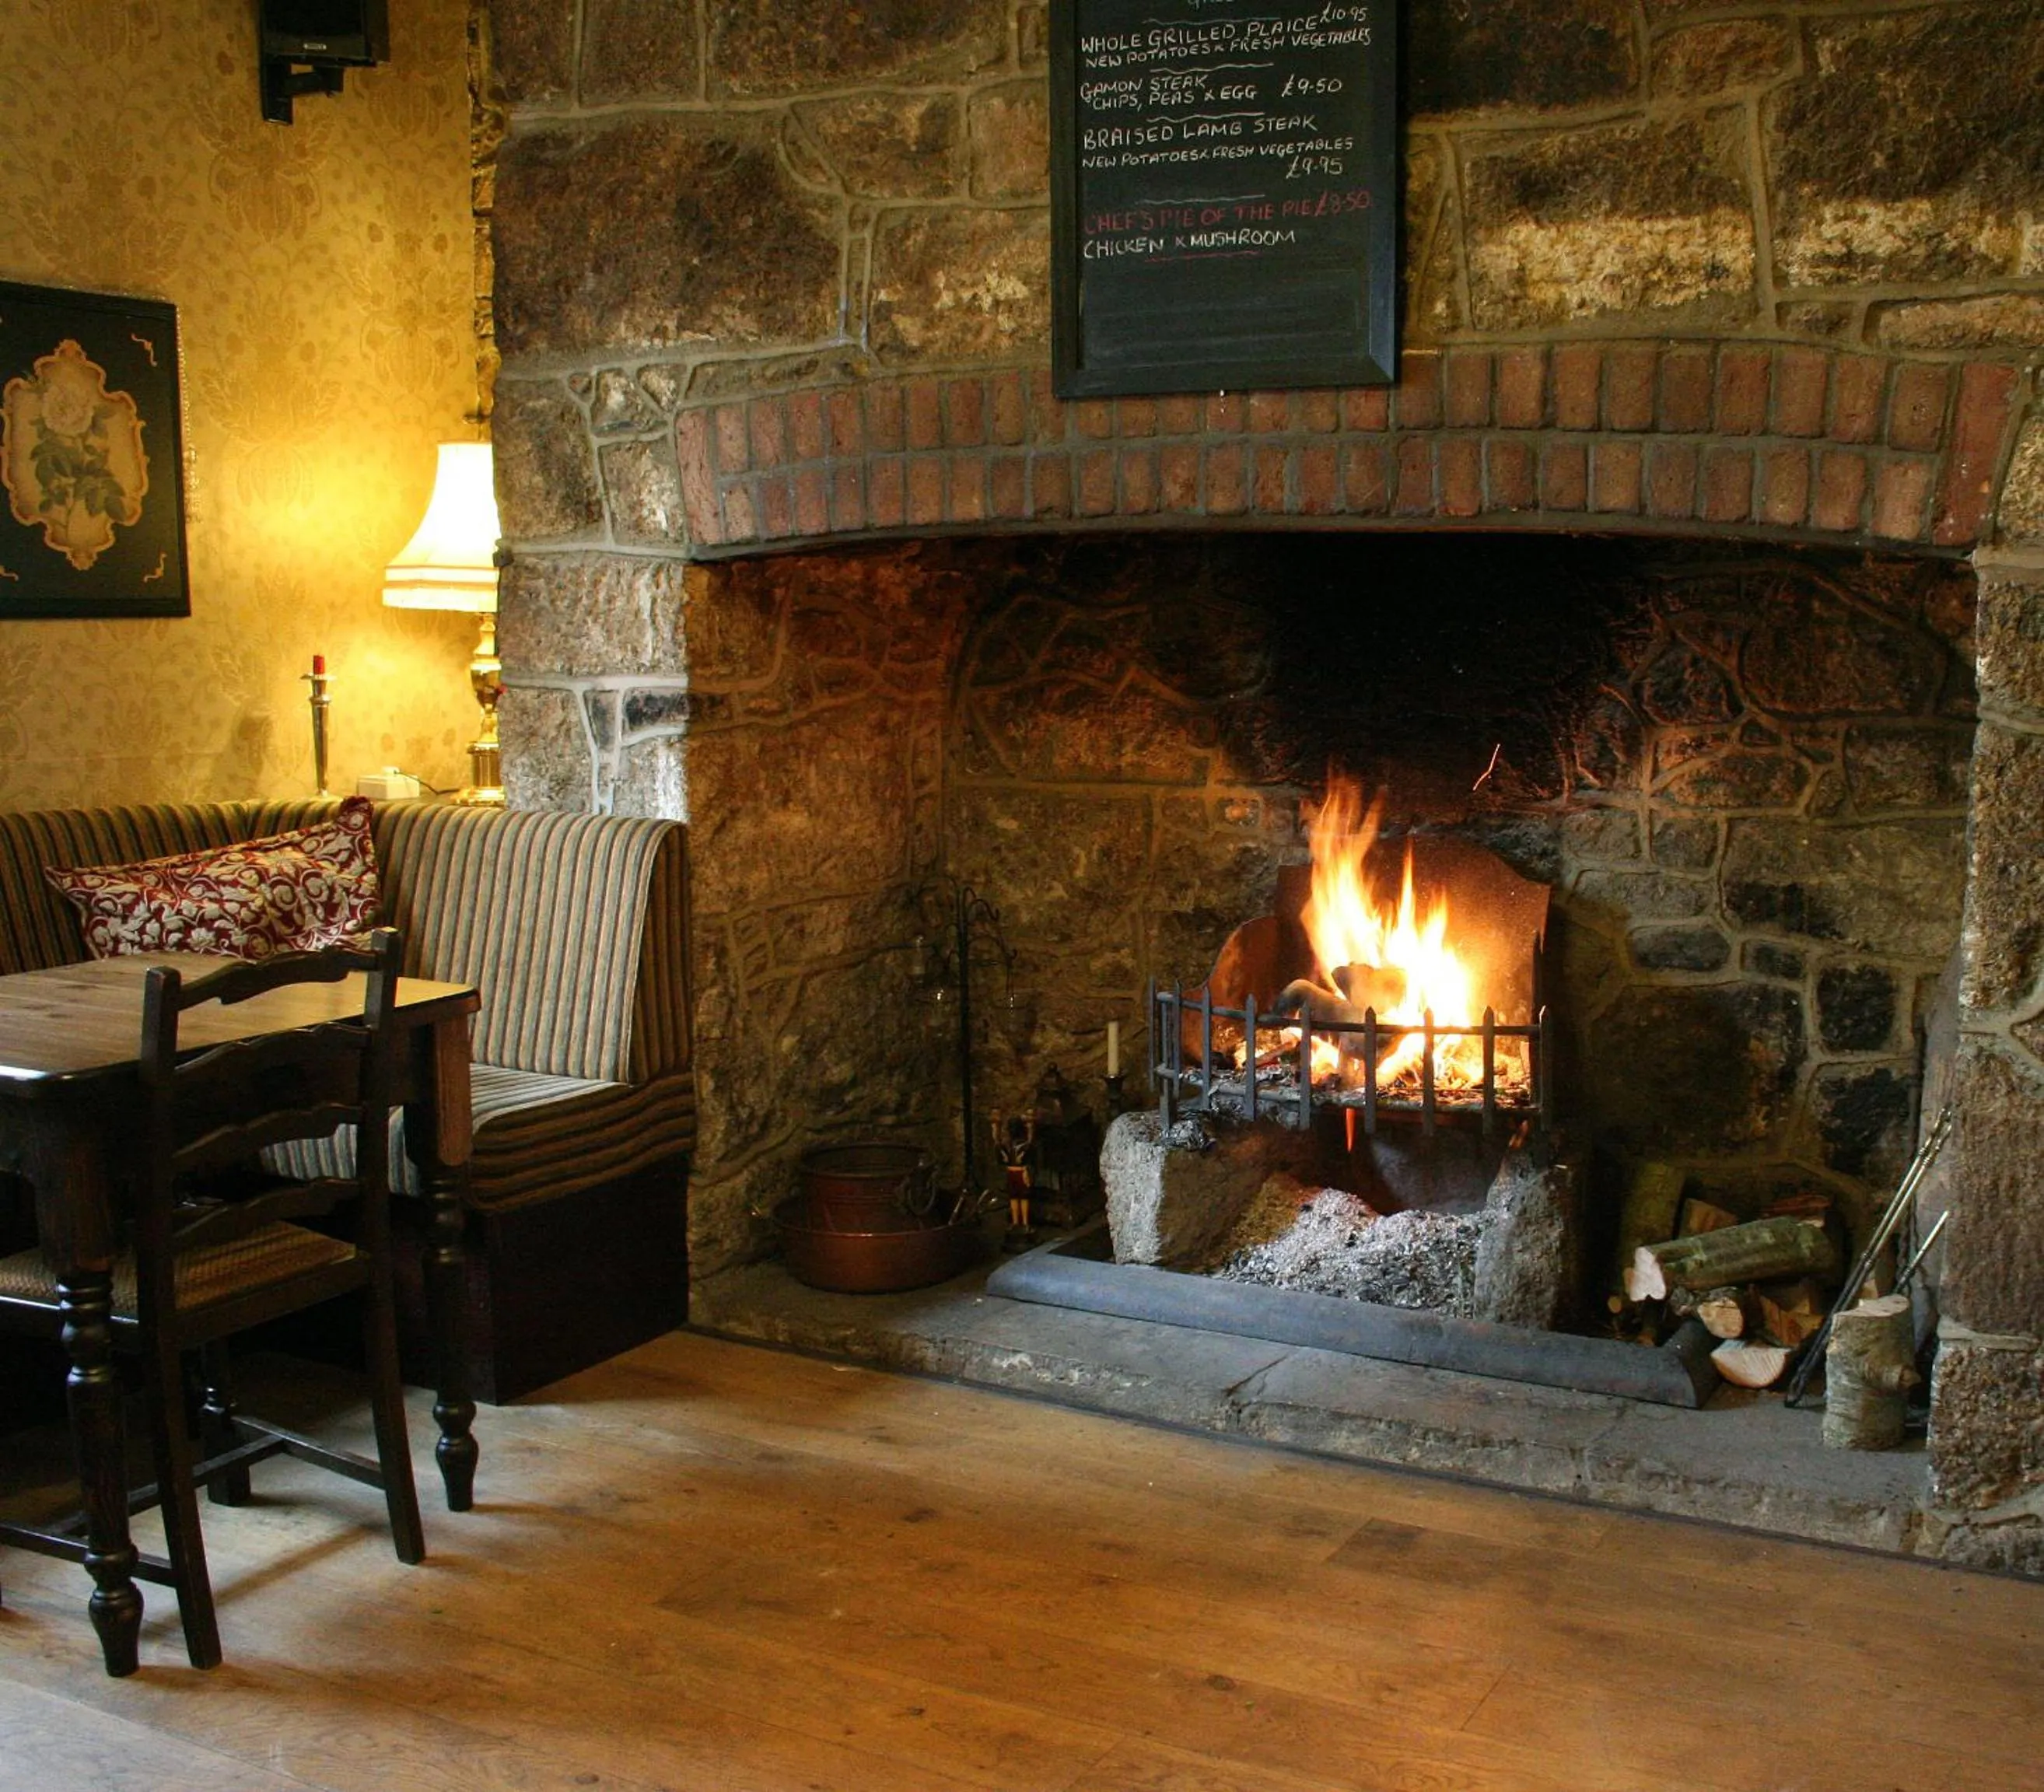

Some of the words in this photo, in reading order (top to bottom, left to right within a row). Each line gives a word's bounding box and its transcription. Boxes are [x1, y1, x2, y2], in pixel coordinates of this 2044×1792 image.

[1081, 34, 1142, 53] WHOLE
[1148, 24, 1235, 50] GRILLED
[1247, 16, 1318, 37] PLAICE
[1086, 55, 1122, 68] NEW
[1127, 44, 1211, 64] POTATOES
[1230, 37, 1284, 52] FRESH
[1291, 27, 1371, 49] VEGETABLES
[1080, 78, 1143, 103] GAMON
[1150, 75, 1209, 92] STEAK
[1150, 90, 1195, 106] PEAS
[1220, 85, 1258, 101] EGG
[1084, 126, 1174, 150] BRAISED
[1183, 122, 1243, 138] LAMB
[1254, 115, 1318, 133] STEAK
[1083, 156, 1117, 169] NEW
[1122, 149, 1199, 166] POTATOES
[1212, 145, 1254, 159] FRESH
[1260, 137, 1353, 158] VEGETABLES
[1200, 208, 1226, 226] OF
[1083, 236, 1164, 259] CHICKEN
[1190, 229, 1296, 248] MUSHROOM
